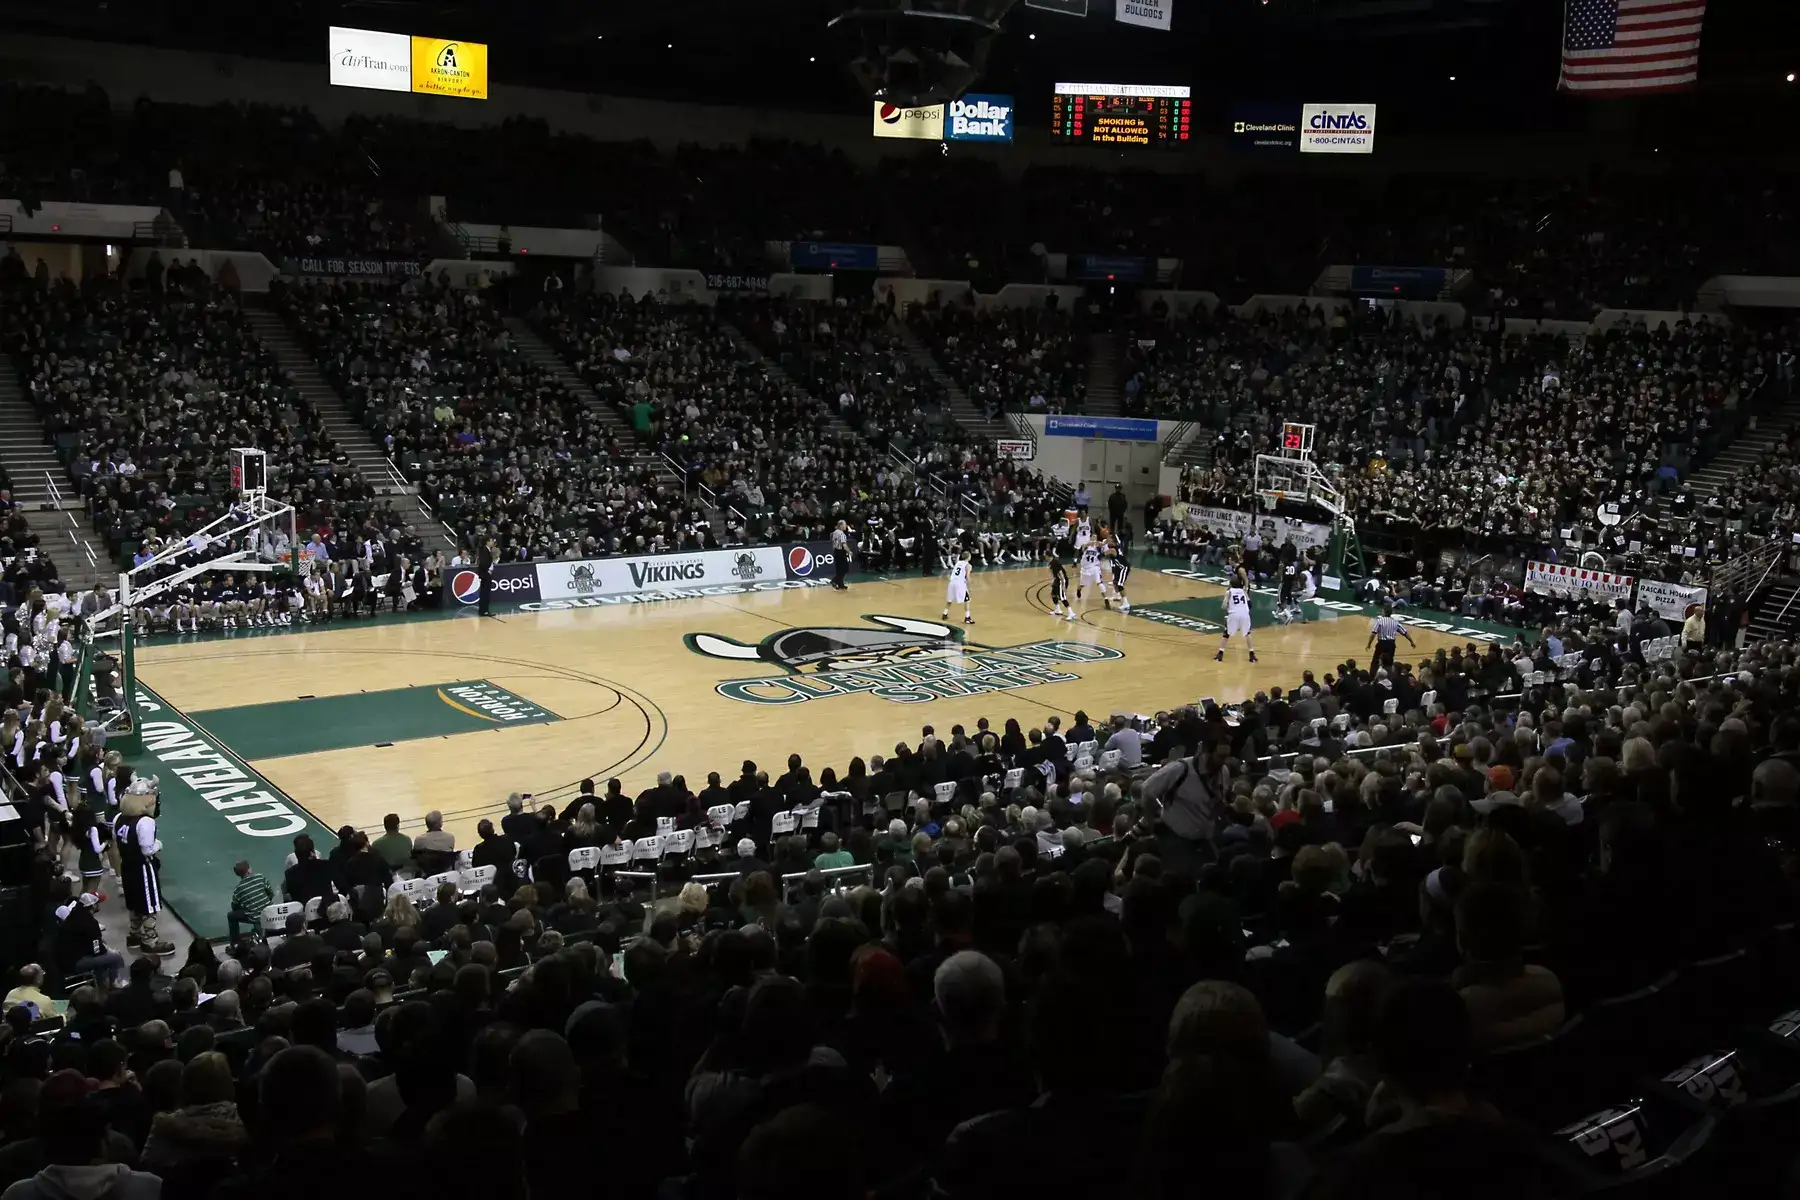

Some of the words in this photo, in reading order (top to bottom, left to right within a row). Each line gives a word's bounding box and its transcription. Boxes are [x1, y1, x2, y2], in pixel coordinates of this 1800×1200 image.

[342, 54, 408, 72] airTran.com
[431, 67, 470, 77] AKRON-CANTON
[904, 109, 940, 121] pepsi
[949, 100, 1009, 120] Dollar
[952, 117, 1006, 136] Bank
[1098, 118, 1136, 126] SMOKING
[1137, 118, 1145, 126] is
[1245, 124, 1276, 132] Cleveland
[1277, 124, 1296, 132] Clinic
[1116, 135, 1149, 145] Building
[302, 258, 325, 273] CALL
[327, 260, 345, 273] FOR
[348, 262, 384, 274] SEASON
[625, 561, 705, 589] VIKINGS
[955, 567, 961, 576] 3
[1285, 565, 1295, 575] 30
[1527, 570, 1567, 583] JUNCTION
[1570, 578, 1593, 588] AUTO
[1595, 583, 1630, 594] FAMILY
[1232, 595, 1246, 605] 54
[1655, 595, 1676, 604] PIZZA
[716, 639, 1126, 705] CLEVELAND
[870, 662, 1083, 704] STATE
[447, 686, 529, 720] HORIZON
[141, 721, 307, 838] CLEVELAND
